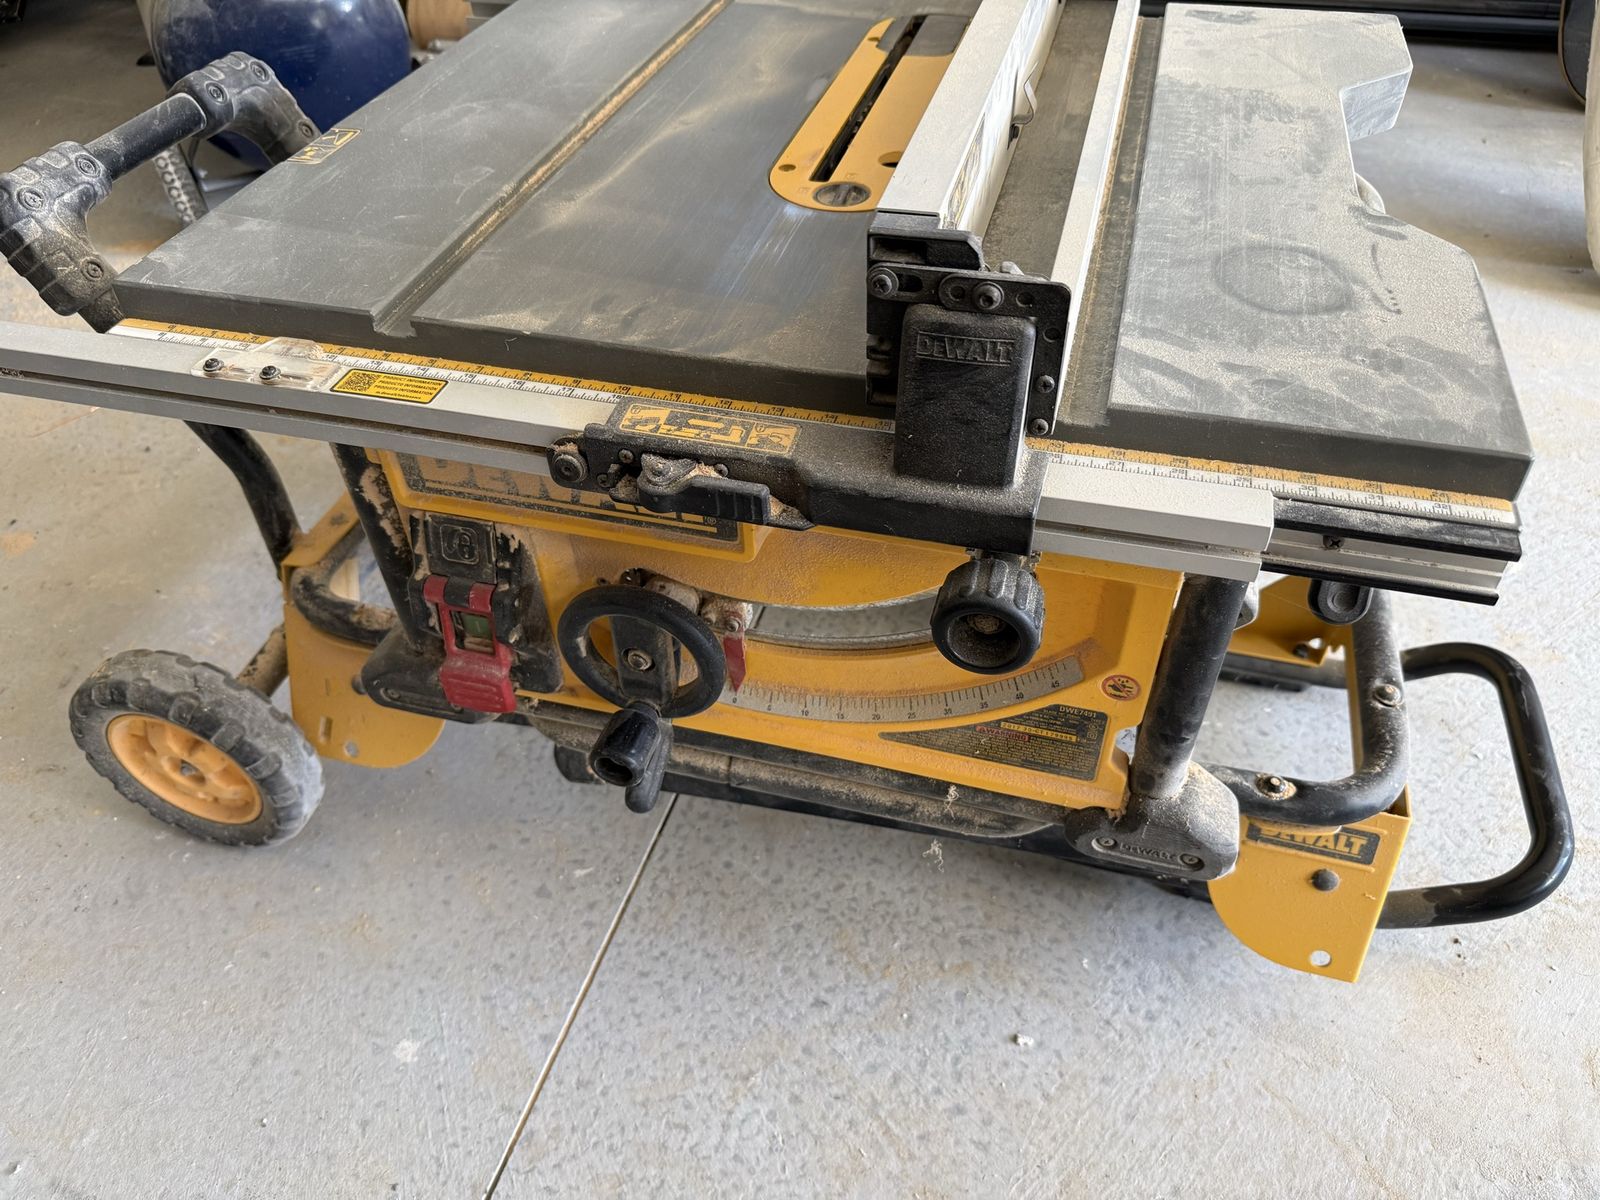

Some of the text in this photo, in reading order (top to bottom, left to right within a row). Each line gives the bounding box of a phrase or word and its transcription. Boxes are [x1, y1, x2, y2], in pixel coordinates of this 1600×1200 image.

[407, 378, 441, 386] INFORMATION
[980, 701, 988, 709] 35
[1015, 692, 1024, 700] 40
[1059, 705, 1097, 718] DWE7491
[985, 727, 1027, 741] WARNING
